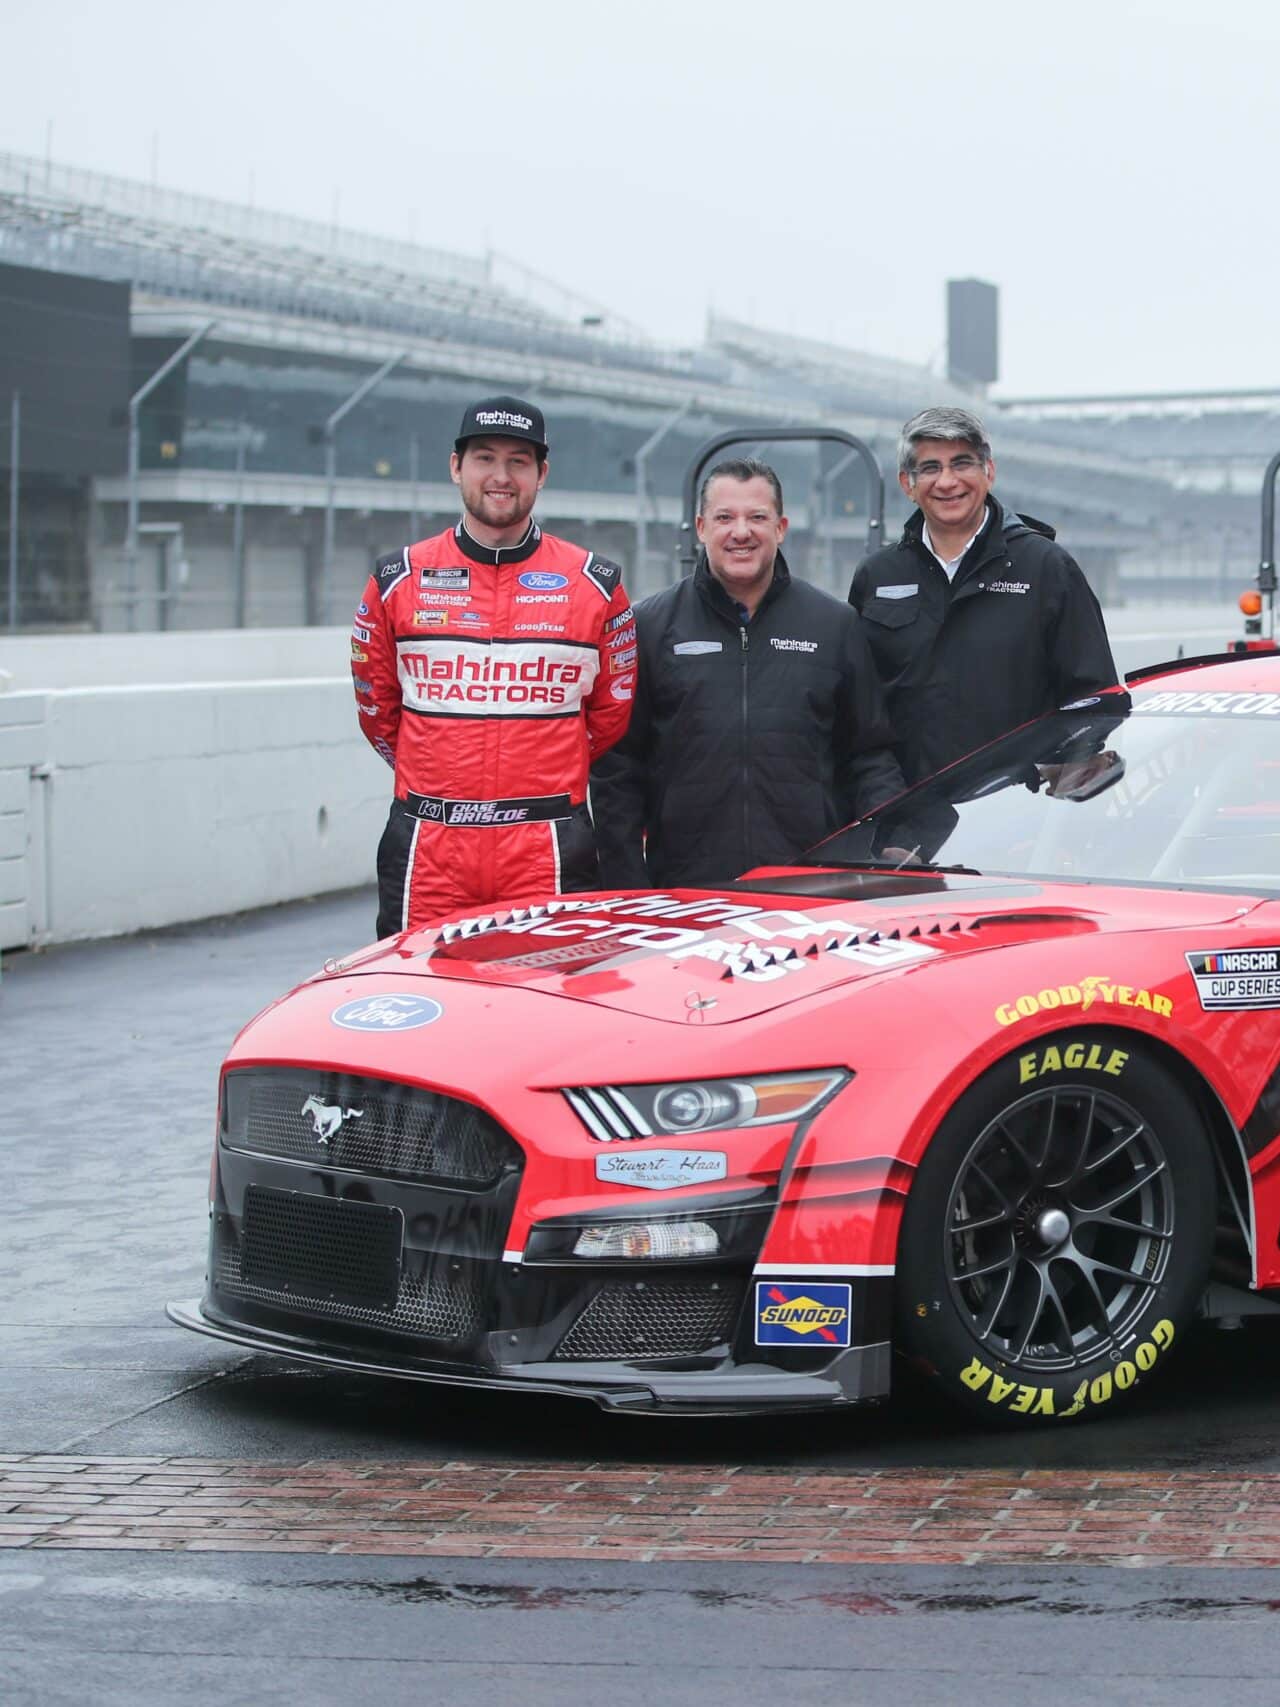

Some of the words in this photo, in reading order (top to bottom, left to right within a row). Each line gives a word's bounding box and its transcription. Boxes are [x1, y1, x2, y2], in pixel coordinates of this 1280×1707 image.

[480, 419, 529, 430] TRACTORS
[416, 682, 565, 703] TRACTORS
[448, 808, 529, 823] BRISCOE
[452, 803, 497, 813] CHASE
[1222, 952, 1278, 972] NASCAR
[1211, 980, 1236, 996] CUP
[343, 996, 423, 1026] Ford
[1018, 1043, 1129, 1084] EAGLE
[765, 1307, 843, 1324] SUNOCO
